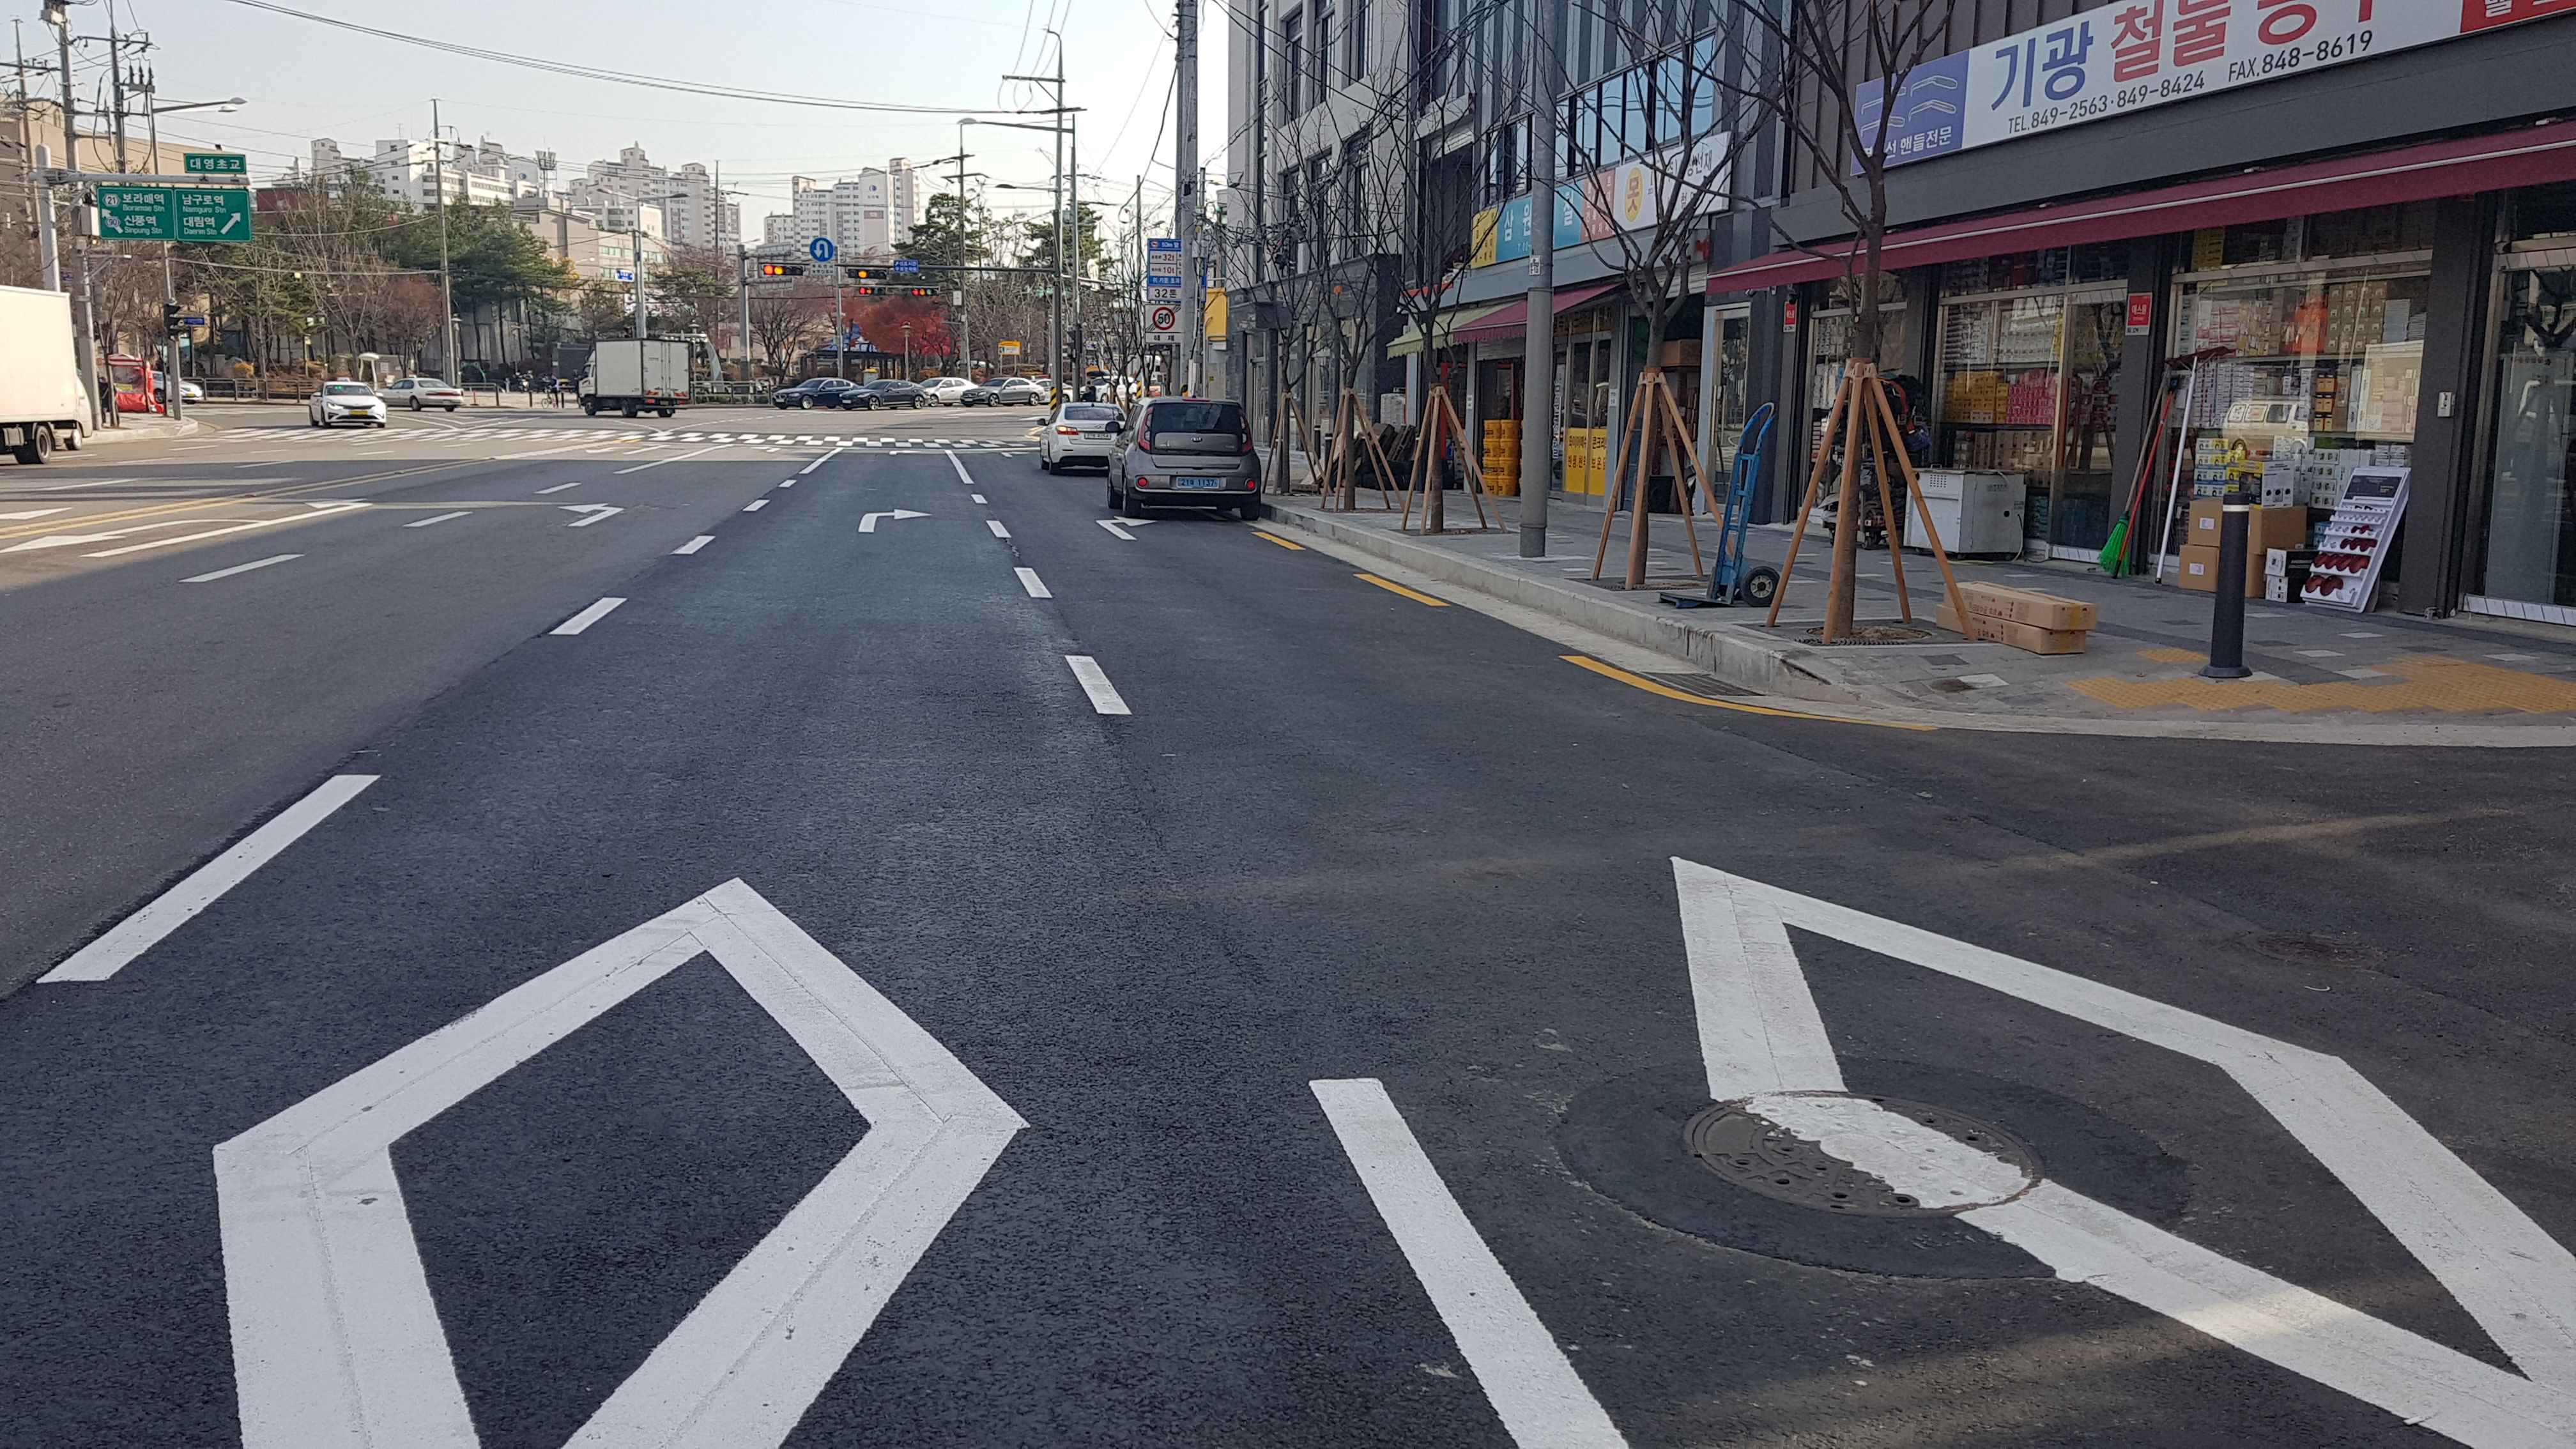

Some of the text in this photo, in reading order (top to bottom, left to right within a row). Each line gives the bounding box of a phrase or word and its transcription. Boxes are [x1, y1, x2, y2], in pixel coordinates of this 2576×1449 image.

[2228, 30, 2373, 82] FAX.848-8619
[1991, 22, 2094, 111] 기광
[1901, 126, 1952, 155] 핸들전문
[190, 158, 241, 170] 대영초교
[107, 196, 116, 205] 21
[123, 194, 165, 204] 보라매역
[182, 194, 224, 206] 남구로역
[1627, 176, 1640, 213] 못
[183, 206, 213, 214] Namguro
[124, 215, 157, 226] 신풍역
[183, 217, 215, 227] 대림역
[1158, 313, 1170, 325] 50
